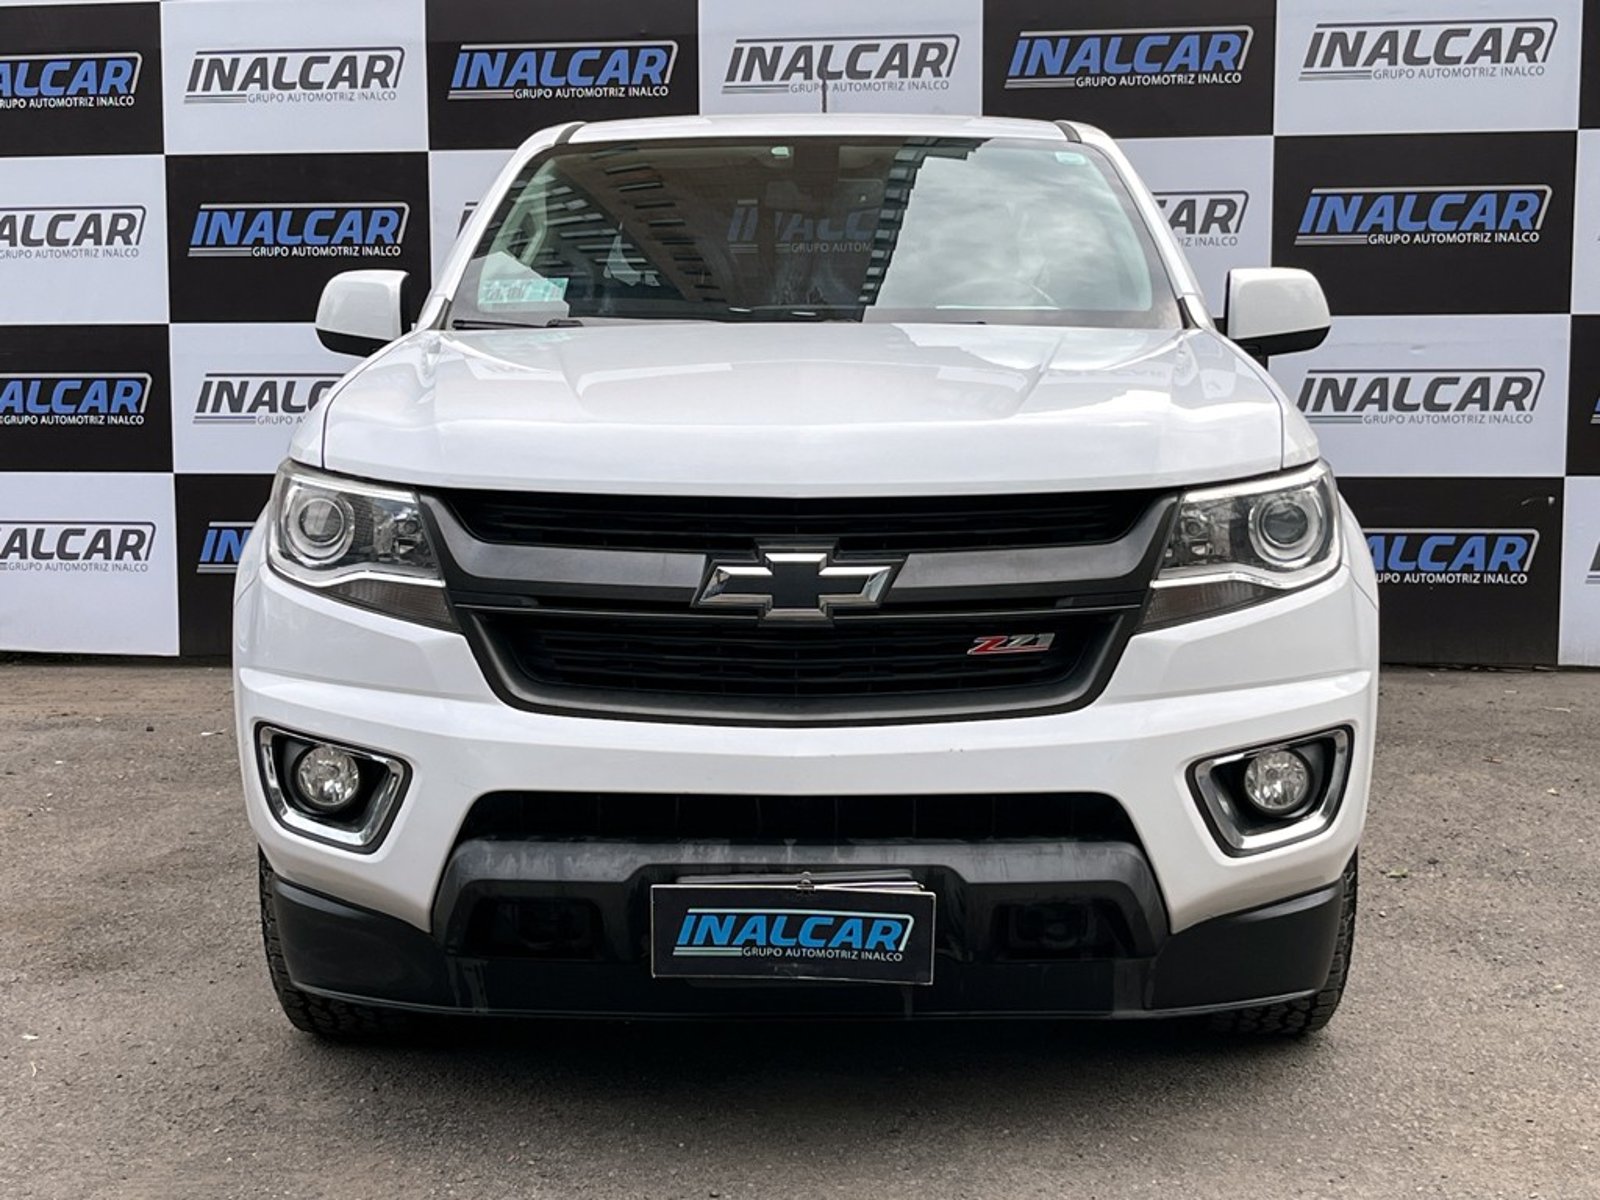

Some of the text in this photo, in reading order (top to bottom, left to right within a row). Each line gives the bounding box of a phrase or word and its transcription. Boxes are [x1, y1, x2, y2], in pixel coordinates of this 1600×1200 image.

[1008, 34, 1242, 76] INALCAR
[1303, 27, 1545, 68] INALCAR
[451, 48, 668, 88] INALCAR
[725, 42, 949, 82] INALCAR
[187, 55, 394, 92] INALCAR
[1075, 72, 1242, 87] GRUPO AUTOMOTRIZ INALCO
[1372, 65, 1545, 80] GRUPO AUTOMOTRIZ INALCO
[514, 86, 669, 99] GRUPO AUTOMOTRIZ INALCO
[832, 81, 905, 92] AUTOMOTRIZ
[907, 80, 949, 91] INALCO
[0, 95, 135, 109] RUPO AUTOMOTRIZ INALCO
[247, 91, 396, 104] GRUPO AUTOMOTRIZ INALCO
[1298, 192, 1540, 233] INALCAR
[0, 213, 137, 247] ALCAR
[190, 210, 399, 245] INALCAR
[1195, 236, 1238, 247] INALCO
[1368, 232, 1540, 245] GRUPO AUTOMOTRIZ INALCO
[35, 249, 99, 259] AUTOMOTRIZ
[102, 248, 139, 258] INALCO
[252, 246, 401, 257] GRUPO AUTOMOTRIZ INALCO
[0, 380, 142, 413] ALCAR
[196, 381, 338, 413] INALC
[1297, 377, 1533, 412] INALCAR
[4, 415, 145, 425] GRUPO AUTOMOTRIZ INALCO
[257, 415, 293, 425] GRUPO
[1363, 414, 1533, 425] GRUPO AUTOMOTRIZ INALCO
[0, 528, 146, 561] ALCAR
[1366, 535, 1528, 572] ALCAR
[8, 562, 149, 572] GRUPO AUTOMOTRIZ INALCO
[1376, 573, 1528, 584] UPO AUTOMOTRIZ INALCO
[967, 633, 1055, 655] Z71
[677, 915, 902, 950] INALCAR
[743, 947, 903, 962] GRUPO AUTOMOTRIZ INALCO
